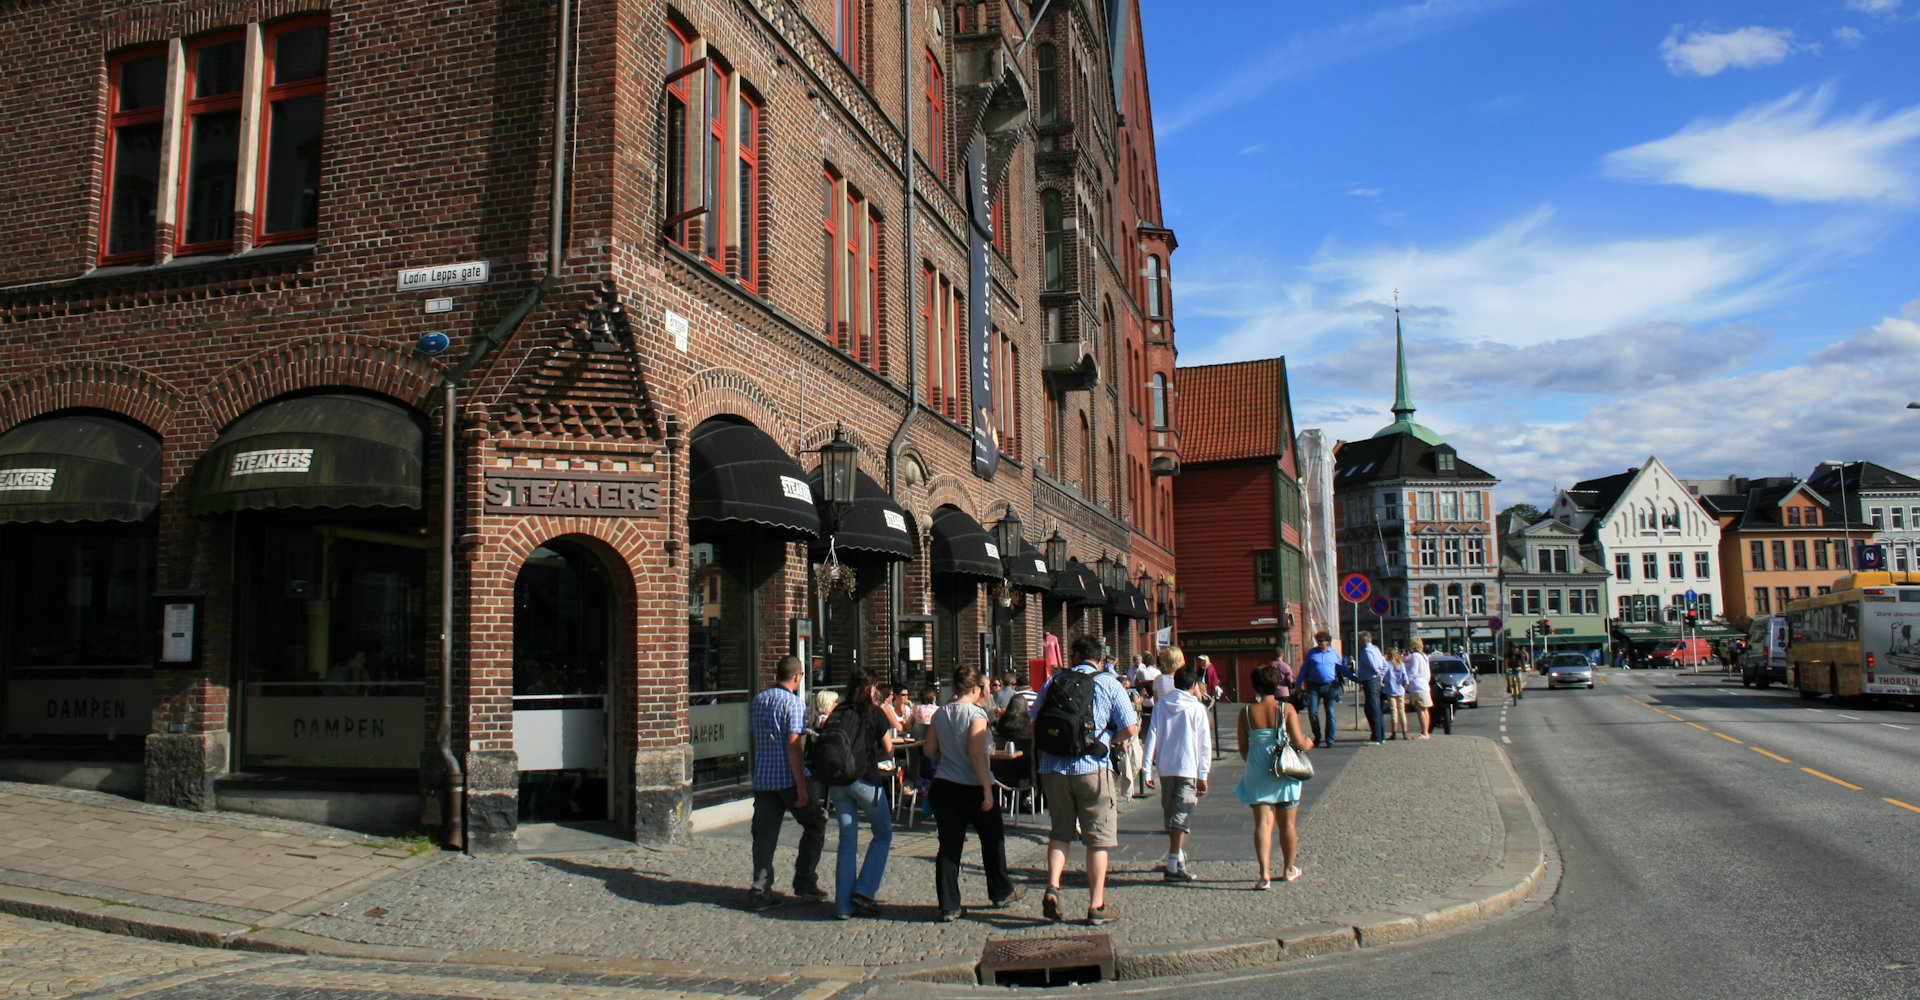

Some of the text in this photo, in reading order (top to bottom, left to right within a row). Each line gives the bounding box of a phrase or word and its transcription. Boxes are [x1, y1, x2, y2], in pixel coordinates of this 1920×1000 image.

[403, 266, 481, 285] Lodin Lepps gate
[232, 453, 312, 471] STEAKERS
[487, 478, 662, 508] STEAKERS
[1866, 552, 1874, 560] N
[46, 698, 125, 718] DAMPEN
[292, 717, 385, 739] DAMPEN
